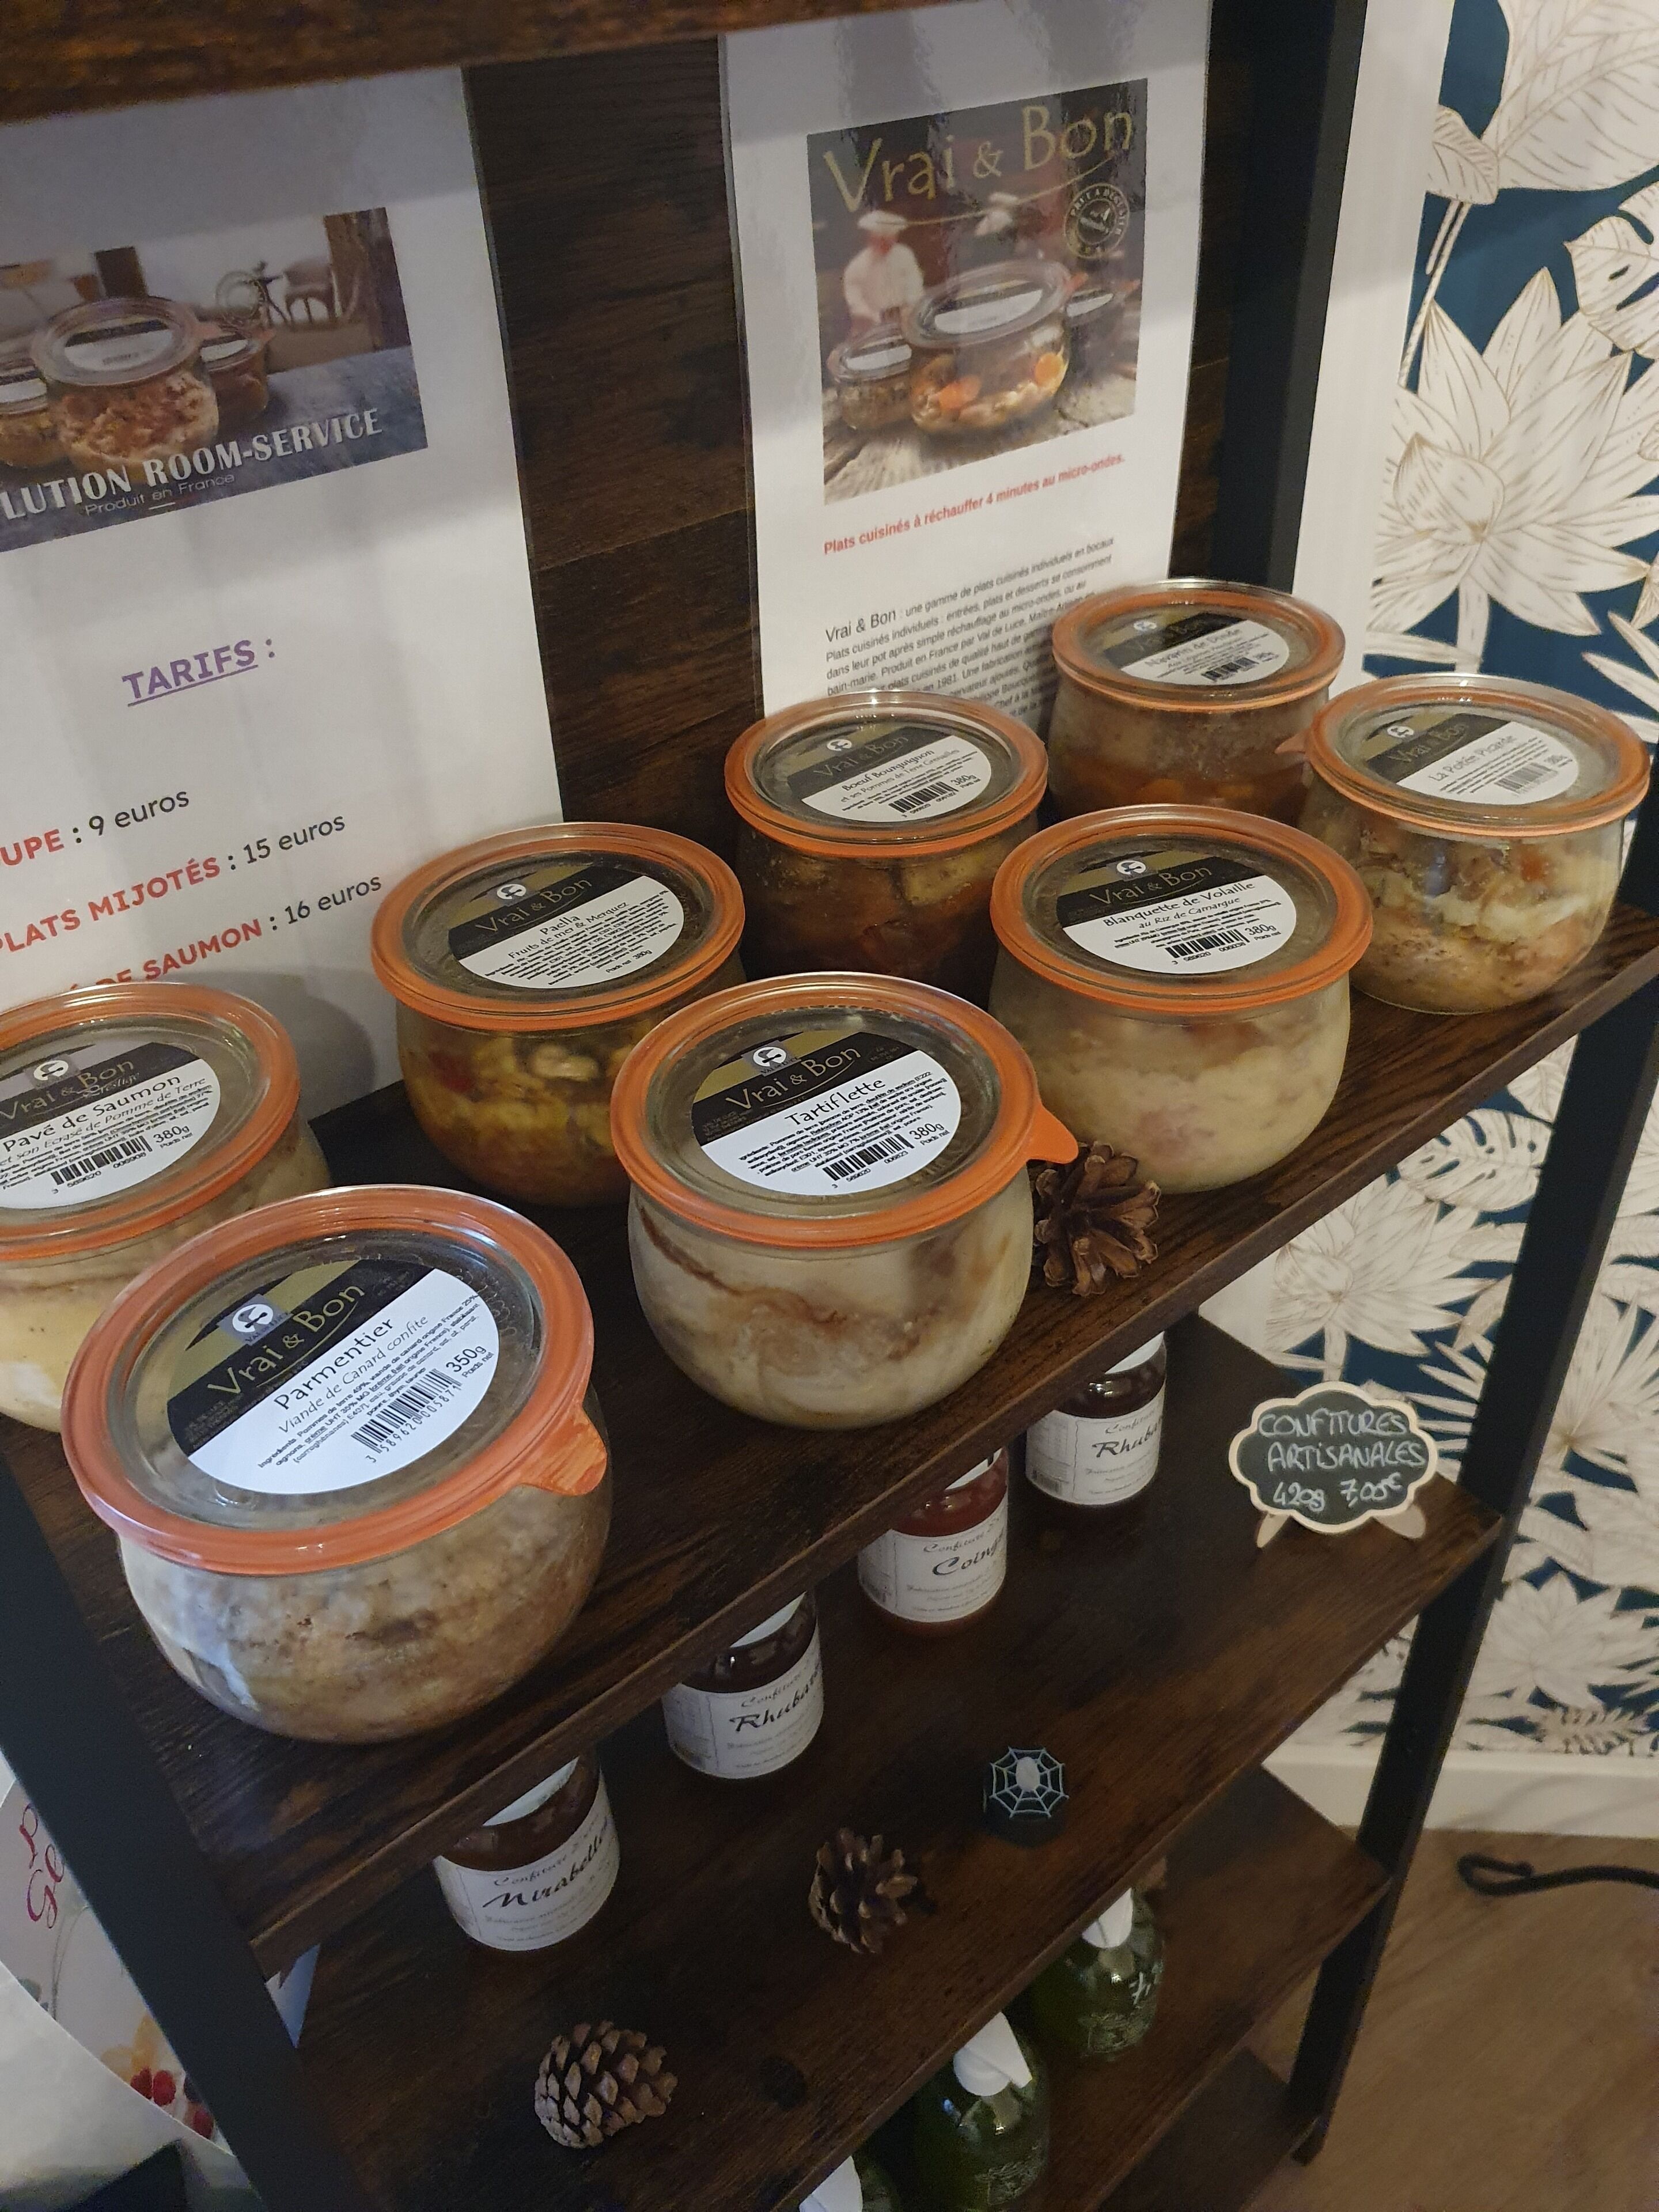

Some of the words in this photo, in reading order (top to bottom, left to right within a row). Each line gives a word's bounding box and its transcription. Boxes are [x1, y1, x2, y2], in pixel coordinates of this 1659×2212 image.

[823, 136, 956, 213] Vrai
[972, 141, 1004, 179] &
[1021, 105, 1132, 171] Bon
[1, 466, 131, 520] LUTION
[142, 408, 382, 488] ROOM-SERVICE
[85, 494, 145, 516] Produit
[152, 489, 172, 501] en
[179, 474, 234, 494] France
[824, 537, 855, 555] Plats
[859, 519, 910, 544] cuisinés
[914, 514, 921, 528] à
[925, 497, 983, 525] réchauffer
[986, 493, 993, 504] 4
[997, 480, 1039, 502] minutes
[1042, 476, 1055, 488] au
[825, 620, 851, 642] Vrai
[855, 618, 866, 633] &
[870, 609, 896, 628] Bon
[906, 604, 923, 617] une
[925, 592, 957, 612] gamme
[122, 639, 255, 699] TARIFS
[826, 646, 850, 662] Plats
[852, 632, 889, 654] cuisinés
[827, 664, 850, 680] dans
[89, 816, 104, 836] 9
[115, 790, 189, 828] euros
[88, 858, 221, 921] MIJOTÉS
[243, 838, 271, 865] 15
[279, 815, 345, 851] euros
[1089, 883, 1143, 904] Vrai
[1158, 867, 1212, 887] Bon
[143, 918, 263, 981] SAUMON
[284, 901, 310, 925] 16
[317, 874, 381, 912] euros
[475, 907, 530, 932] Vrai
[531, 903, 546, 911] &
[540, 880, 592, 903] Bon
[540, 915, 581, 935] Paella
[1103, 902, 1180, 927] Blanquette
[1183, 897, 1200, 906] de
[1200, 882, 1255, 901] Volaille
[1155, 915, 1171, 924] Riz
[1188, 897, 1240, 915] Camargue
[508, 942, 539, 959] Fruits
[541, 937, 554, 945] de
[554, 927, 574, 938] mer
[1244, 924, 1277, 936] 380g
[0, 1090, 55, 1120] Vrai
[77, 1061, 134, 1088] Bon
[725, 1078, 789, 1109] Vrai
[790, 1074, 807, 1085] &
[801, 1048, 861, 1077] Bon
[785, 1080, 885, 1125] Tartiflette
[3, 1124, 56, 1153] Pavé
[62, 1114, 89, 1129] de
[93, 1077, 181, 1116] Saumon
[86, 1122, 101, 1131] de
[105, 1099, 153, 1123] Pomme
[157, 1090, 172, 1101] de
[175, 1078, 206, 1094] Terre
[153, 1125, 190, 1143] 380g
[909, 1123, 945, 1140] 380g
[207, 1345, 283, 1393] Vrai
[282, 1333, 304, 1349] &
[293, 1286, 365, 1332] Bon
[446, 1346, 486, 1373] 350g
[274, 1318, 393, 1410] Parmentier
[279, 1398, 324, 1433] Viande
[326, 1384, 342, 1400] de
[342, 1347, 387, 1384] Canard
[387, 1316, 428, 1350] confite
[1258, 1408, 1410, 1437] CONFITURES
